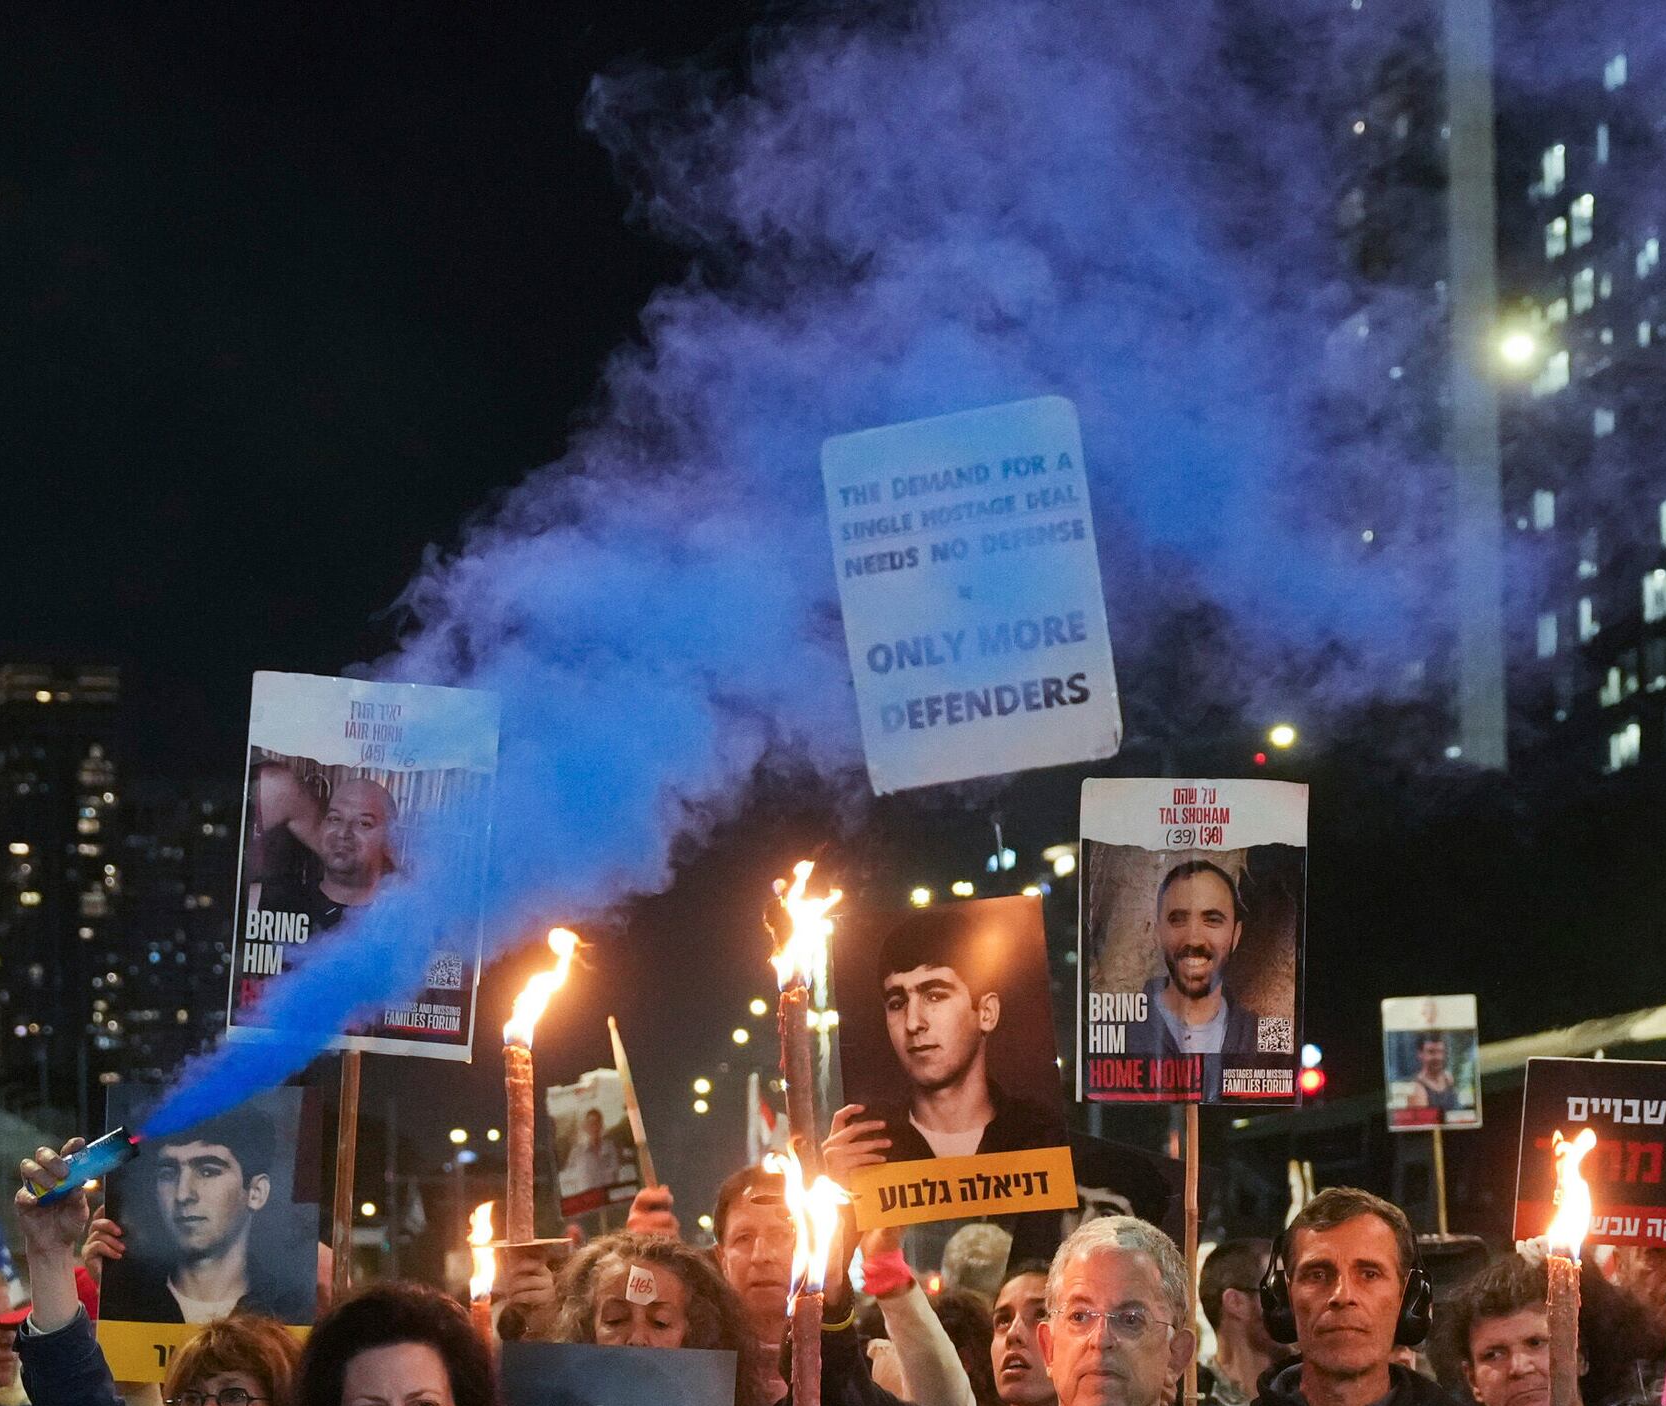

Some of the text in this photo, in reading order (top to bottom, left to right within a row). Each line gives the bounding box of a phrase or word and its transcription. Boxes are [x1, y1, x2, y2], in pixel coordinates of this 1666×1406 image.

[839, 452, 1073, 507] THE DEMAND FOR A
[840, 485, 1079, 541] SINGLE HOSTAGE DEAL
[843, 519, 1085, 578] NEEDS NO DEFENSE
[866, 610, 1087, 675] ONLY MORE
[880, 672, 1091, 733] DEFENDERS
[344, 721, 403, 740] IAIR HORN
[1173, 787, 1217, 805] טל שהם
[1159, 807, 1230, 825] TAL SHOHAM
[1165, 828, 1196, 846] (39)
[245, 909, 310, 944] BRING
[242, 943, 283, 975] HIM
[384, 1011, 461, 1031] FAMILIES FORUM
[433, 1004, 461, 1017] MISSING
[1088, 992, 1148, 1023] BRING
[1088, 1024, 1126, 1054] HIM
[1088, 1055, 1202, 1089] HOME NOW!
[1222, 1069, 1294, 1079] HOSTAGES AND MISSING
[1222, 1078, 1293, 1093] FAMILIES FORUM
[878, 1169, 1050, 1213] דניאלה גלבוע
[628, 1276, 654, 1295] 465
